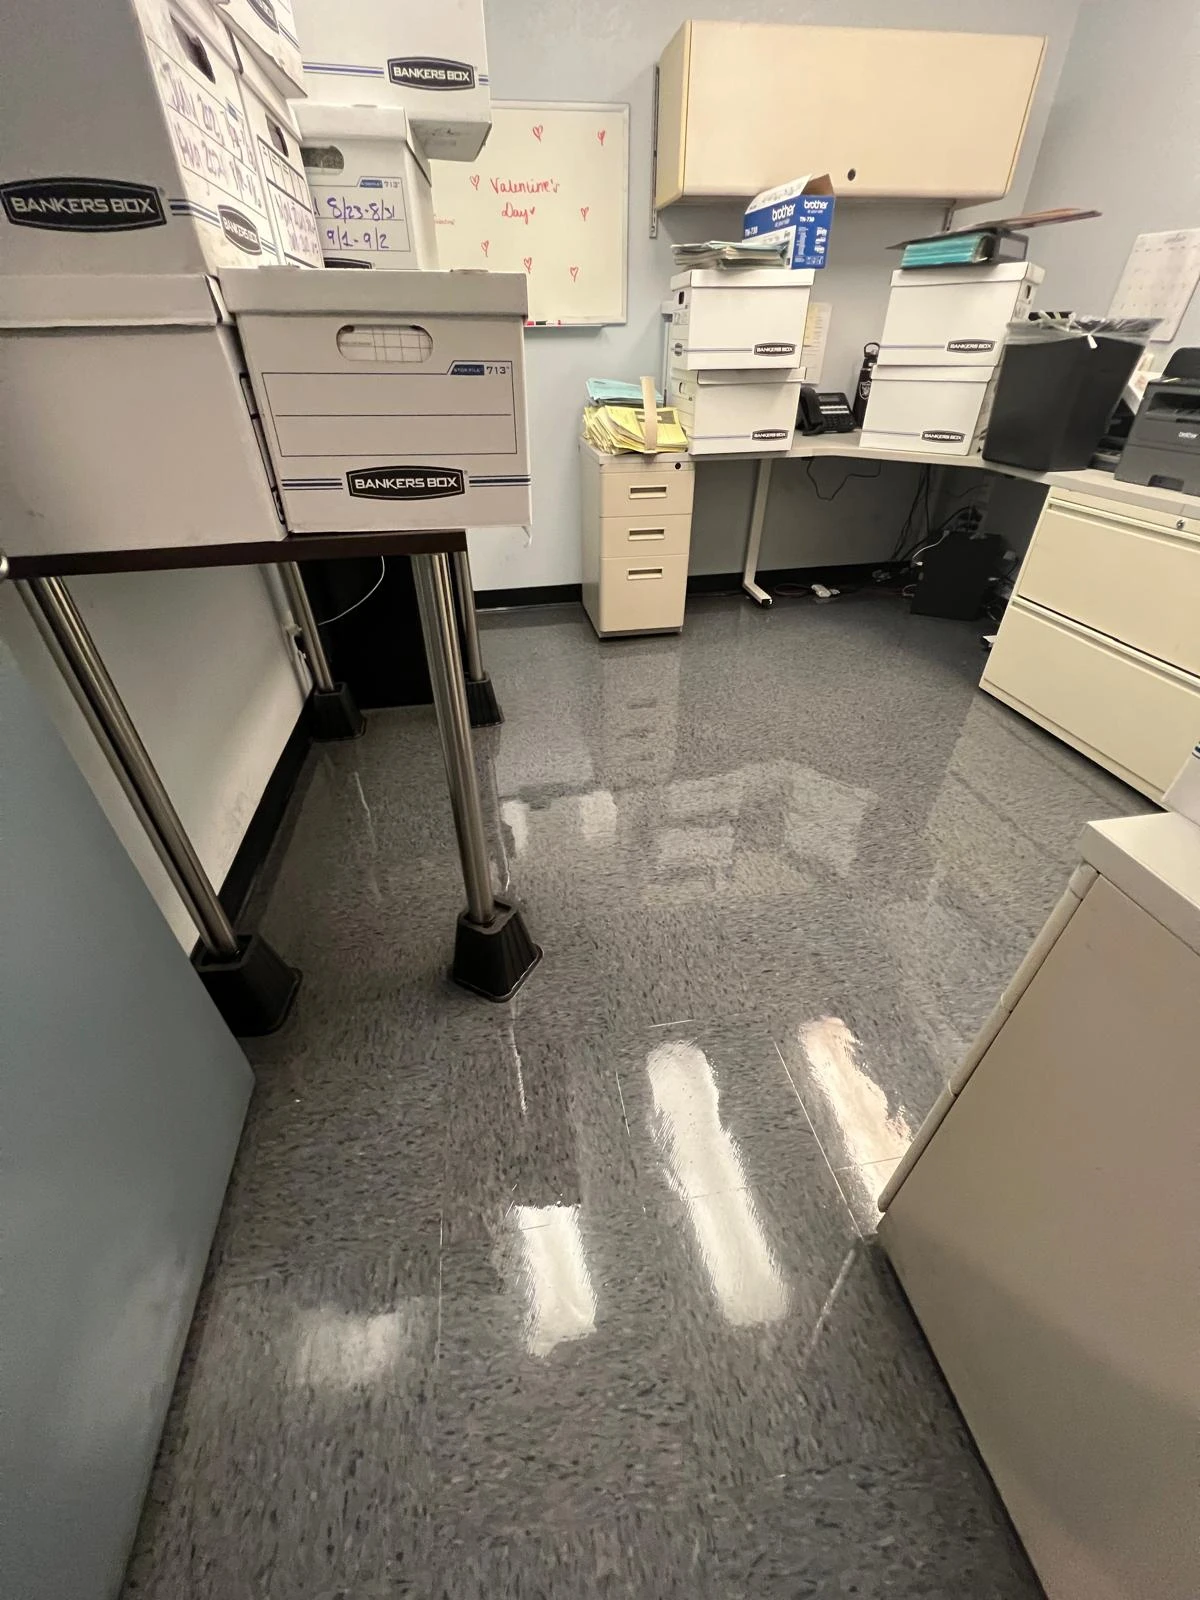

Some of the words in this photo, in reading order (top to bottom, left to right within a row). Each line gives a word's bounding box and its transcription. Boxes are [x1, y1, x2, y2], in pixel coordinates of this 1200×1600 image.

[393, 67, 446, 80] BANKERS
[446, 70, 471, 83] BOX
[490, 177, 560, 194] Valentine's
[10, 197, 109, 214] BANKERS
[111, 198, 156, 214] BOX
[501, 201, 529, 225] Day
[771, 203, 796, 222] brother
[803, 199, 829, 210] brother
[354, 478, 425, 490] BANKERS
[427, 477, 458, 488] BOX
